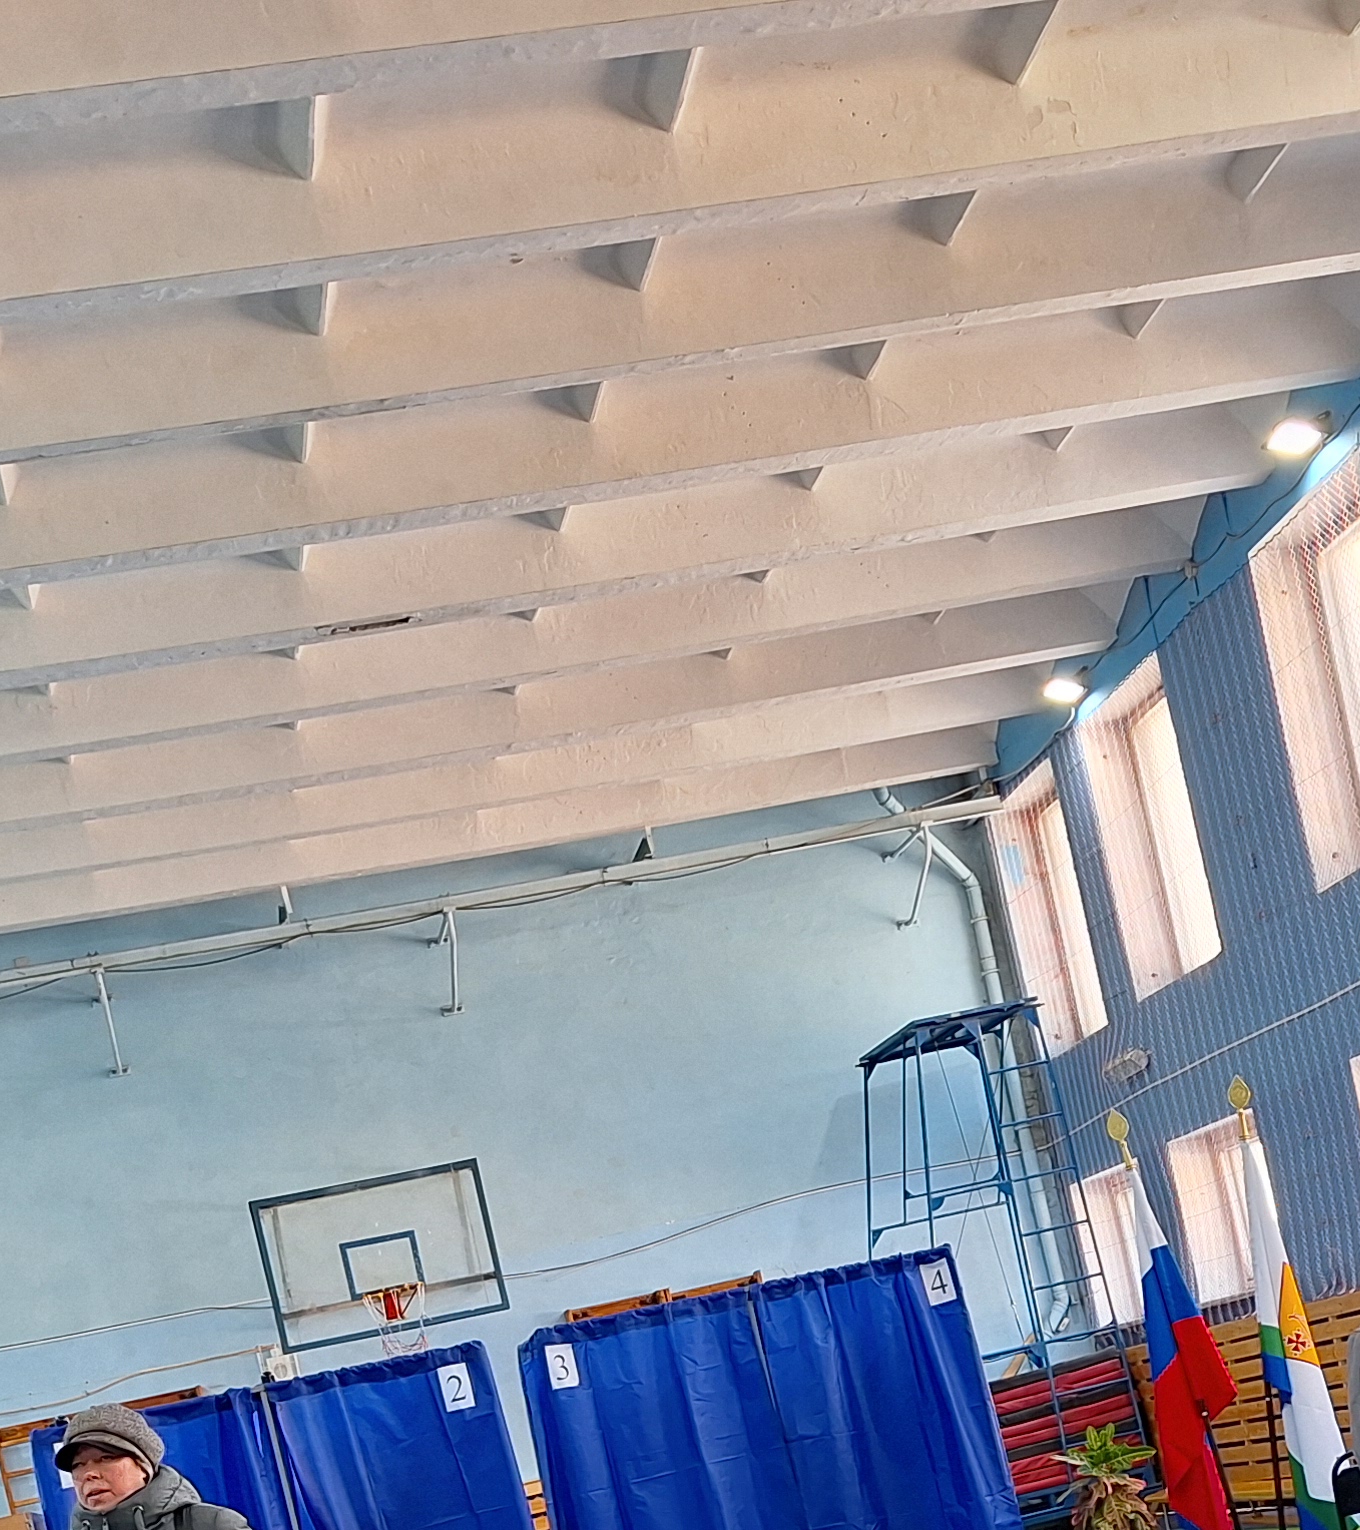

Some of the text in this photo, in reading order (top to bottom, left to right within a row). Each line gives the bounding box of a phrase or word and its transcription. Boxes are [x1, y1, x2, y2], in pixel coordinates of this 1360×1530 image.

[931, 1269, 948, 1294] 4
[553, 1354, 570, 1381] 3
[446, 1375, 467, 1403] 2
